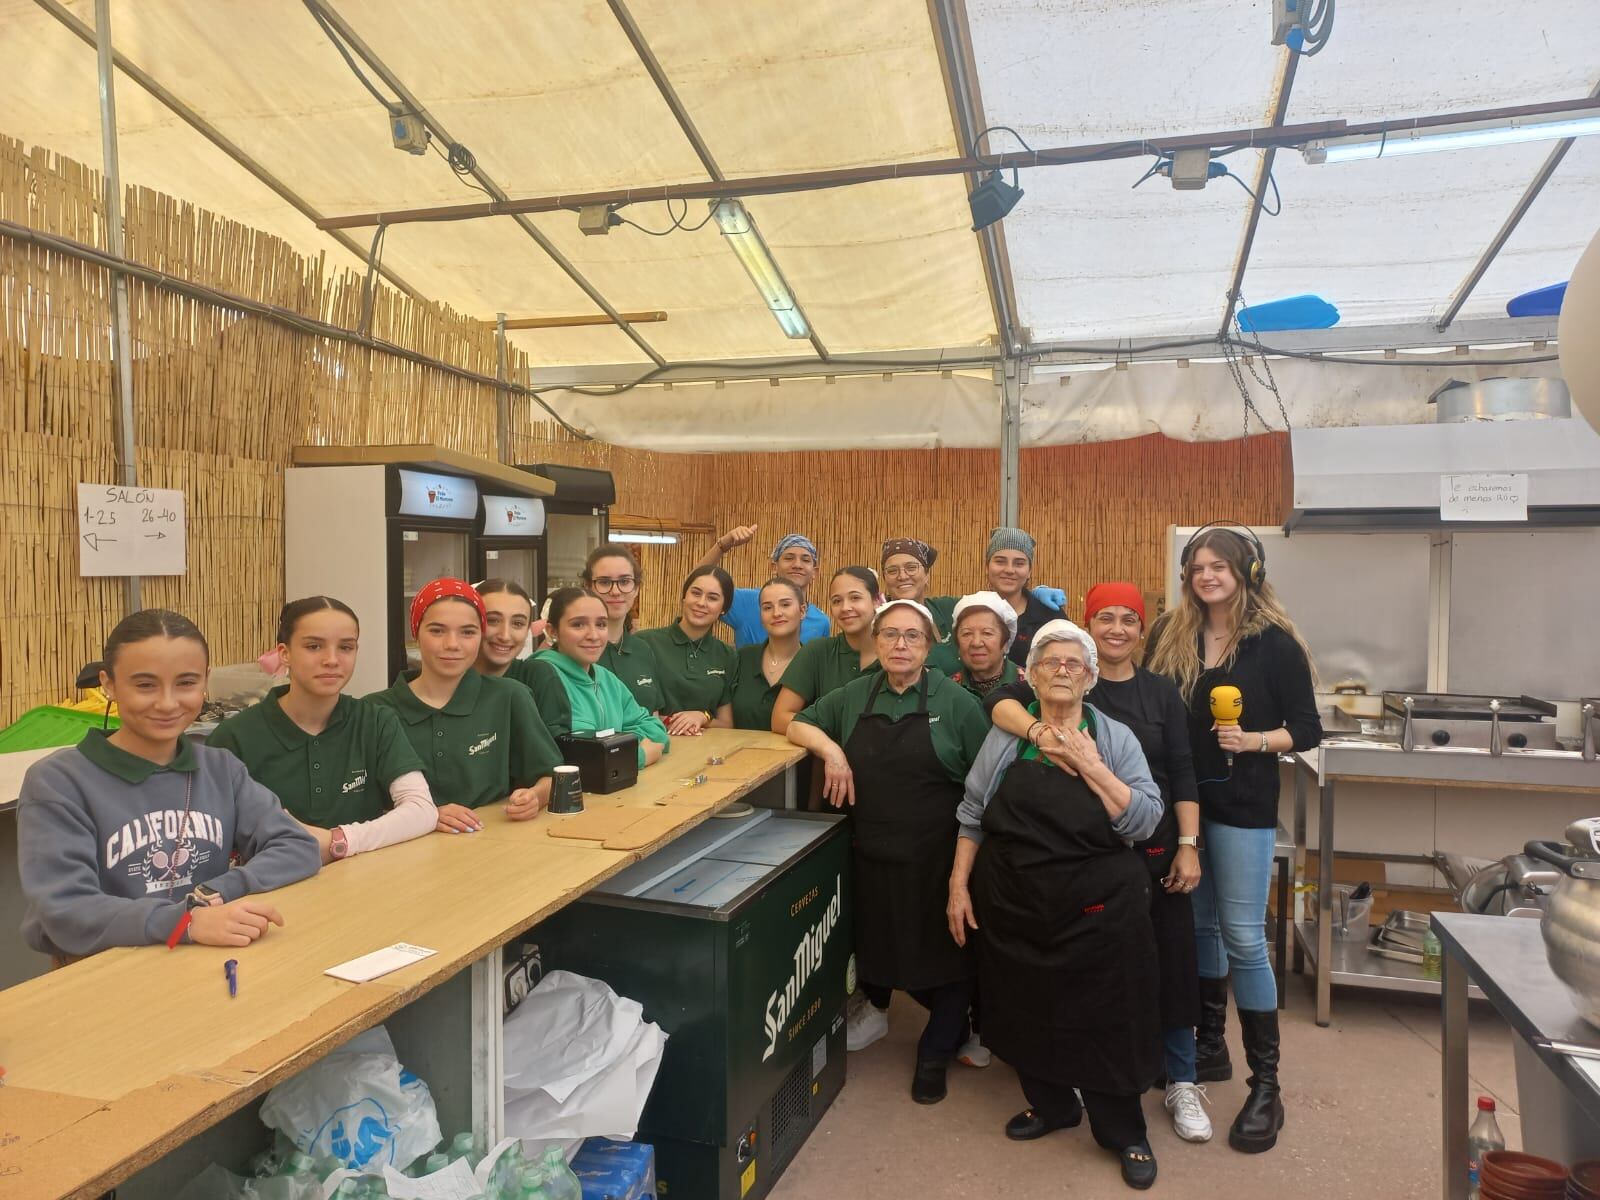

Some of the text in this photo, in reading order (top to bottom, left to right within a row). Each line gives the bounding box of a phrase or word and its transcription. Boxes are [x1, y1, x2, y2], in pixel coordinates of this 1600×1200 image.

[105, 487, 154, 503] SALÓN
[106, 810, 224, 870] CALIFORNIA
[790, 886, 820, 918] CERVEZAS
